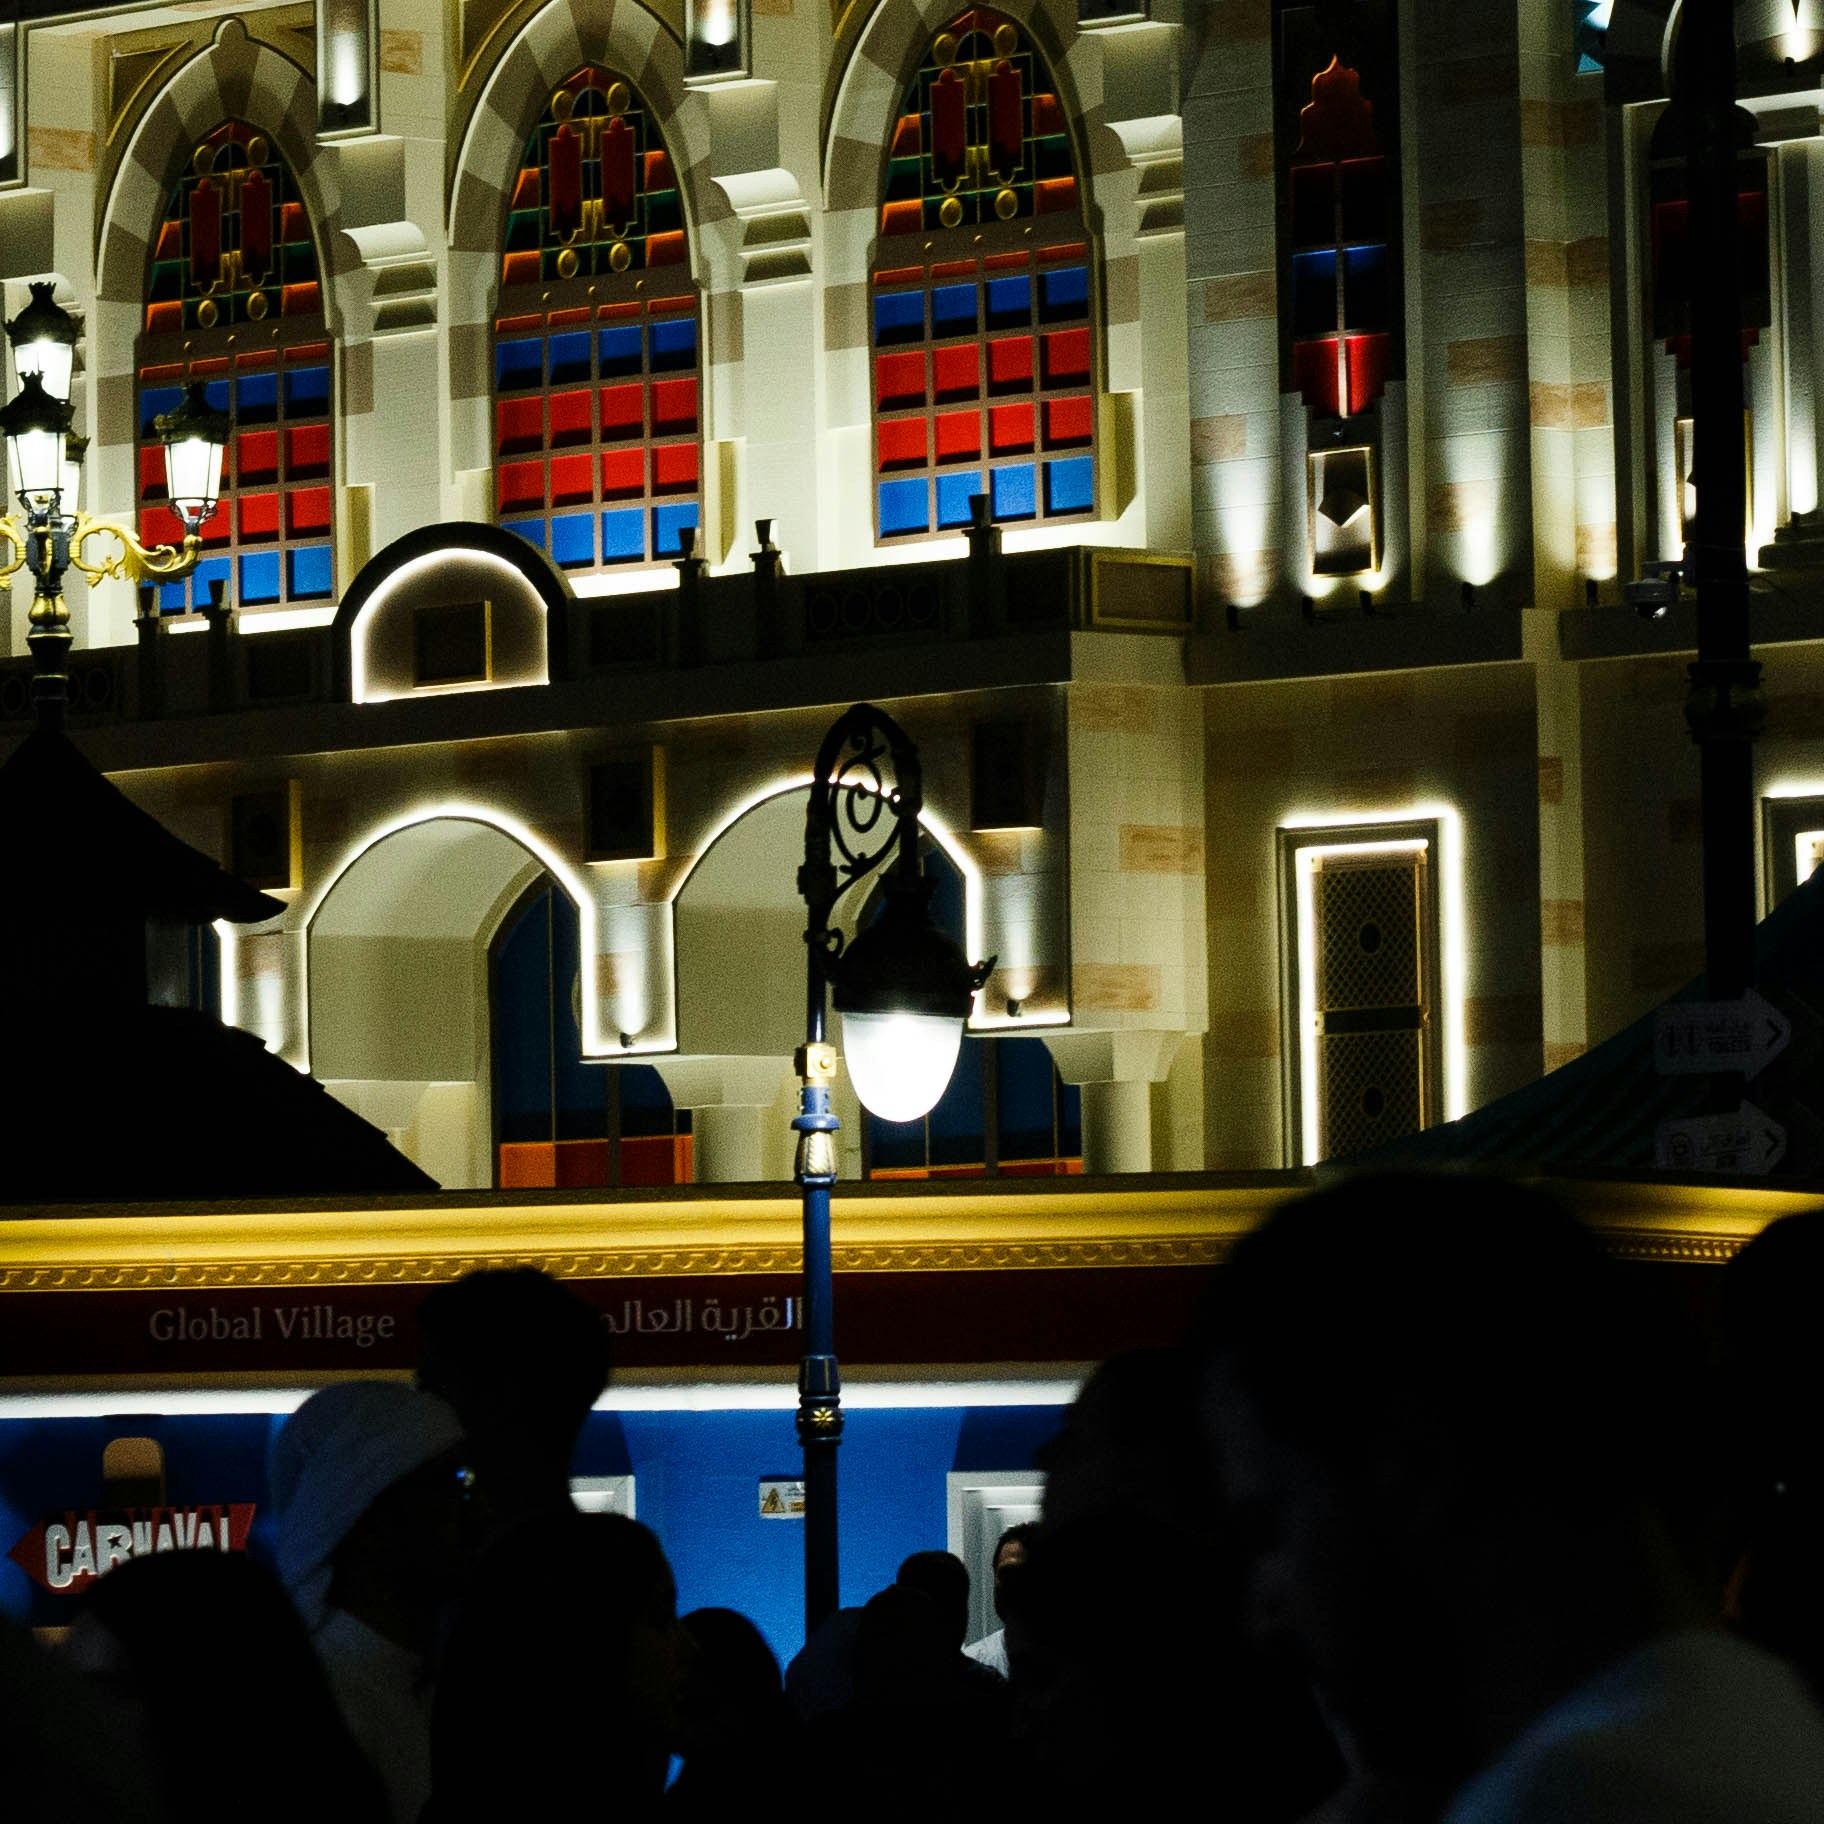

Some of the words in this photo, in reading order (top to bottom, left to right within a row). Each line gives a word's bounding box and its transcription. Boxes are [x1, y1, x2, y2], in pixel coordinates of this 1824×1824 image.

[148, 1306, 262, 1342] Global
[275, 1305, 397, 1348] Village
[599, 1297, 693, 1334] العال
[701, 1296, 804, 1341] القرية
